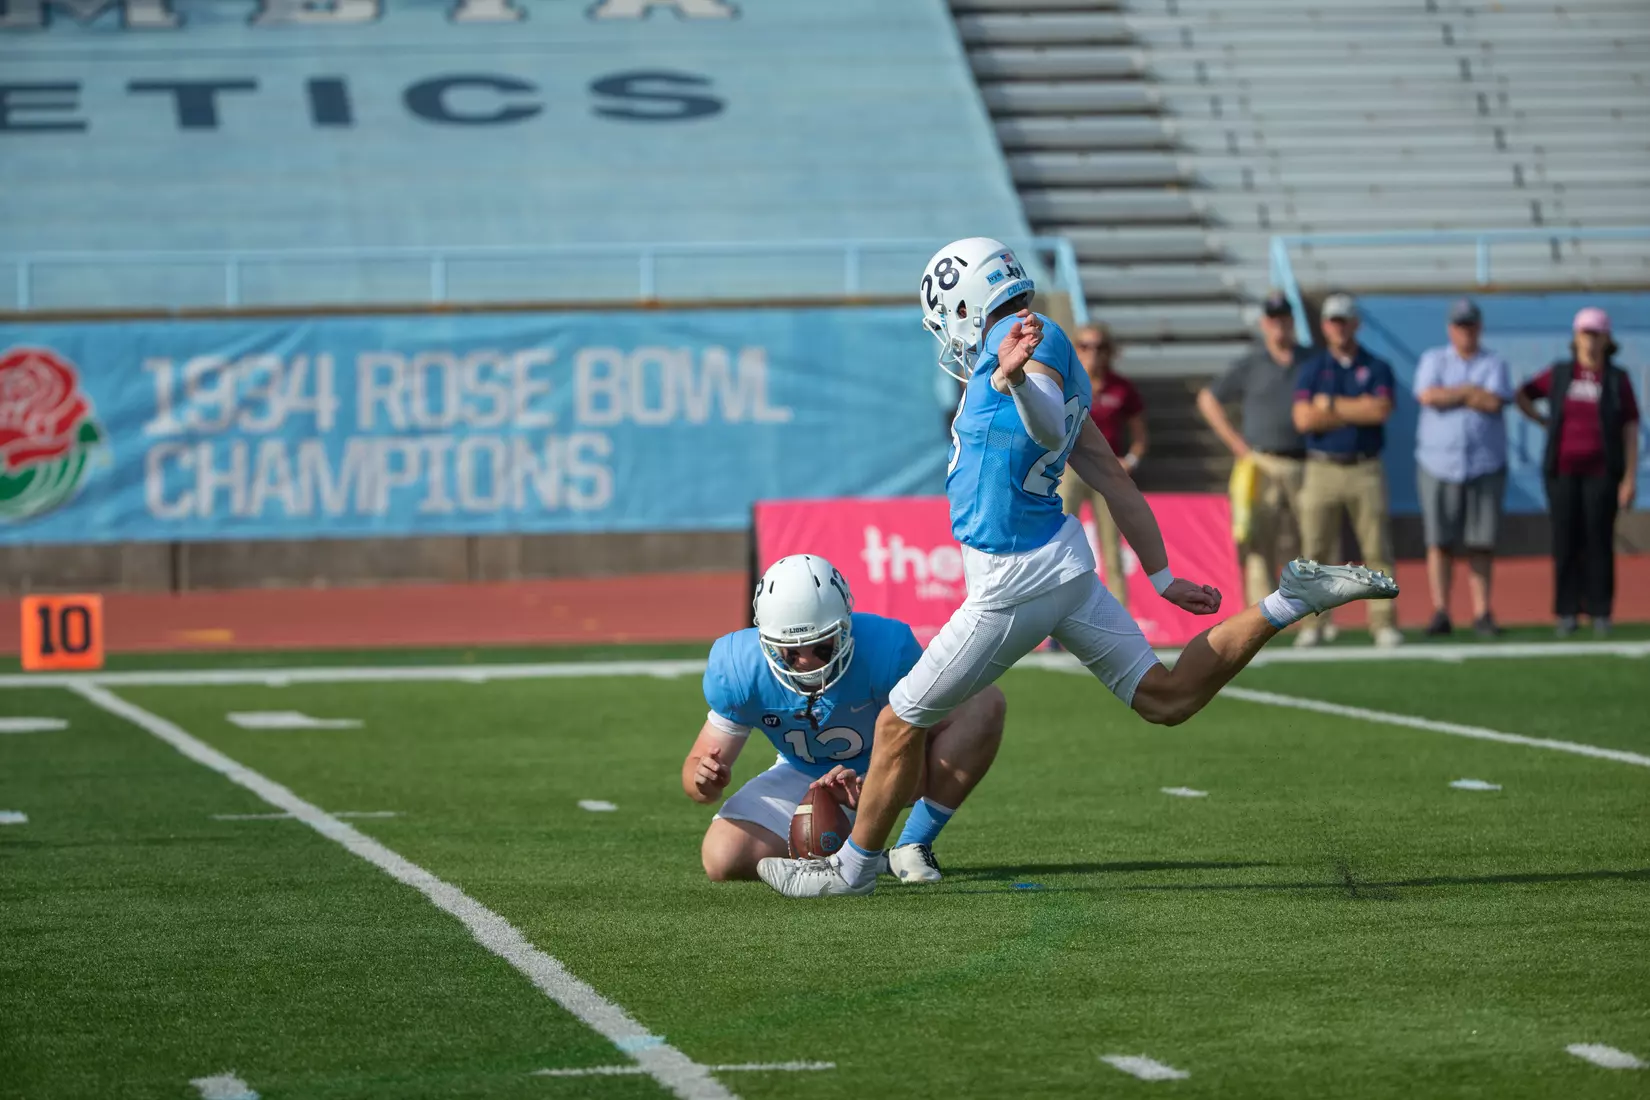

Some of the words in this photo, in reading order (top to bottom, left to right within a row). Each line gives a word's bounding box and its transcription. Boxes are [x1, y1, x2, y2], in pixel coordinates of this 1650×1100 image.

[921, 256, 961, 311] 28
[143, 355, 339, 433] 1934
[356, 347, 555, 430] ROSE
[575, 347, 792, 424] BOWL
[145, 432, 614, 520] CHAMPIONS
[38, 605, 92, 656] 10
[789, 626, 809, 634] LIONS
[764, 716, 778, 726] 67
